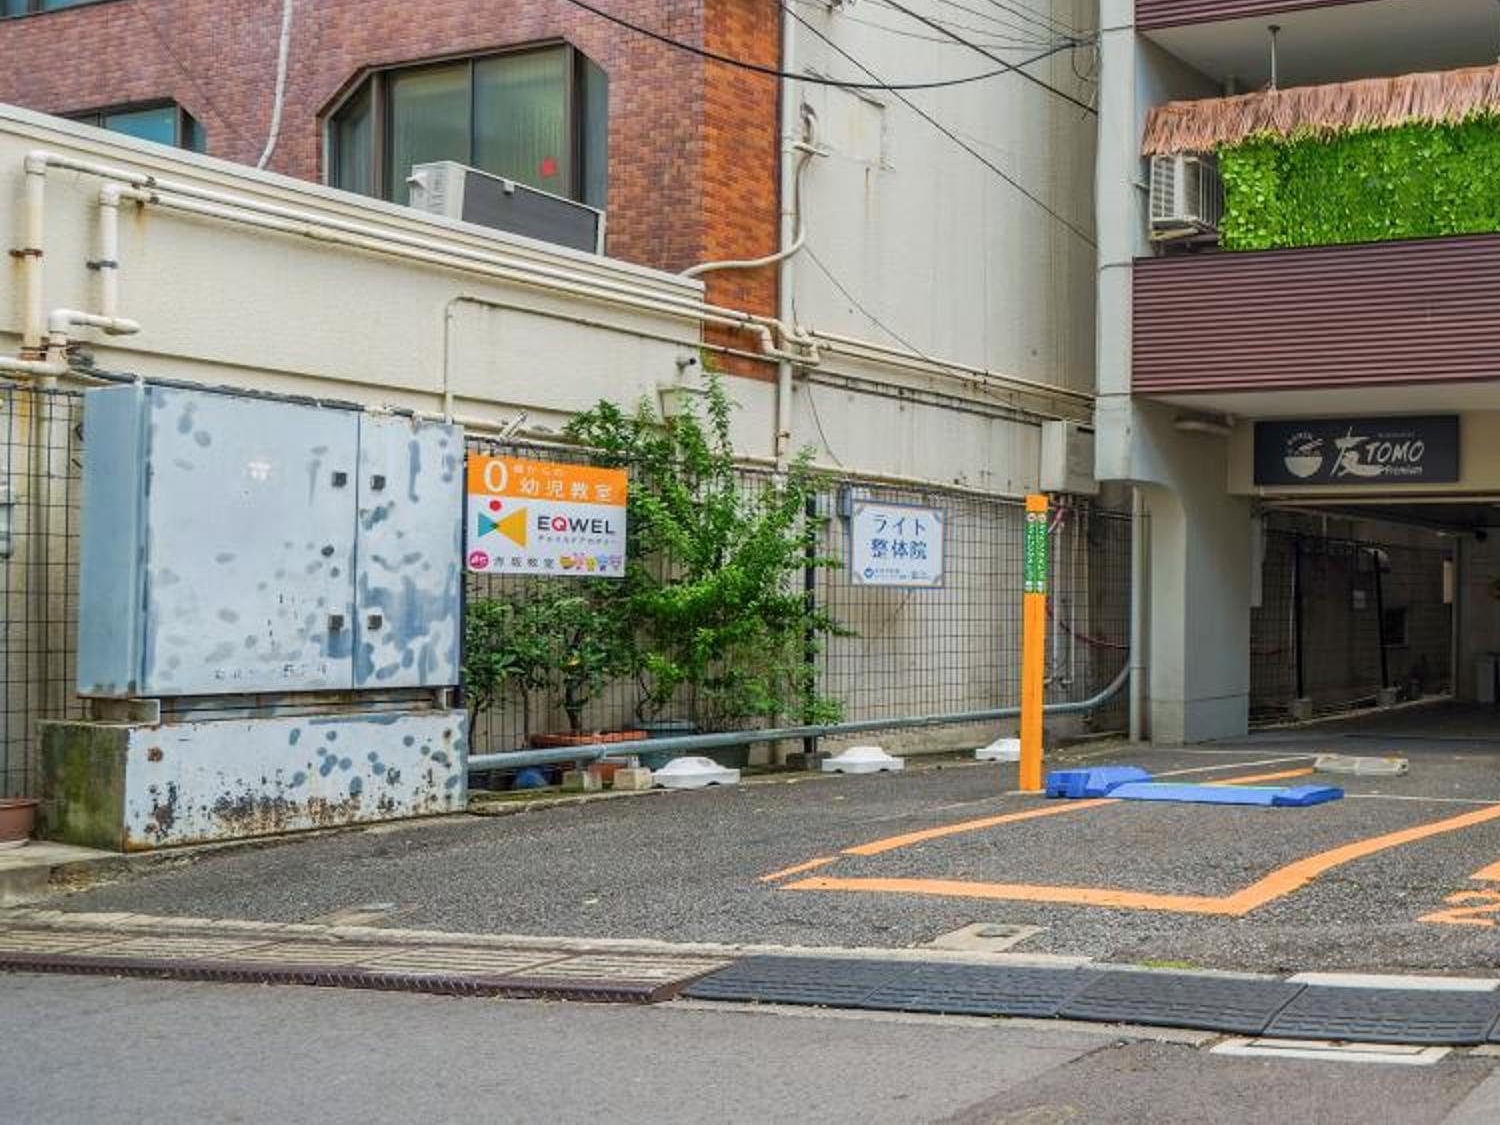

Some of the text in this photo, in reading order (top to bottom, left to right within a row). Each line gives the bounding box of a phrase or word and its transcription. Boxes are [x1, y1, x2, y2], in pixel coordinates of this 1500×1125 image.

[1365, 440, 1425, 463] TOMO
[519, 477, 613, 503] 幼児教室
[537, 515, 616, 535] EQWEL
[873, 514, 927, 537] ライト
[870, 538, 928, 560] 整体院
